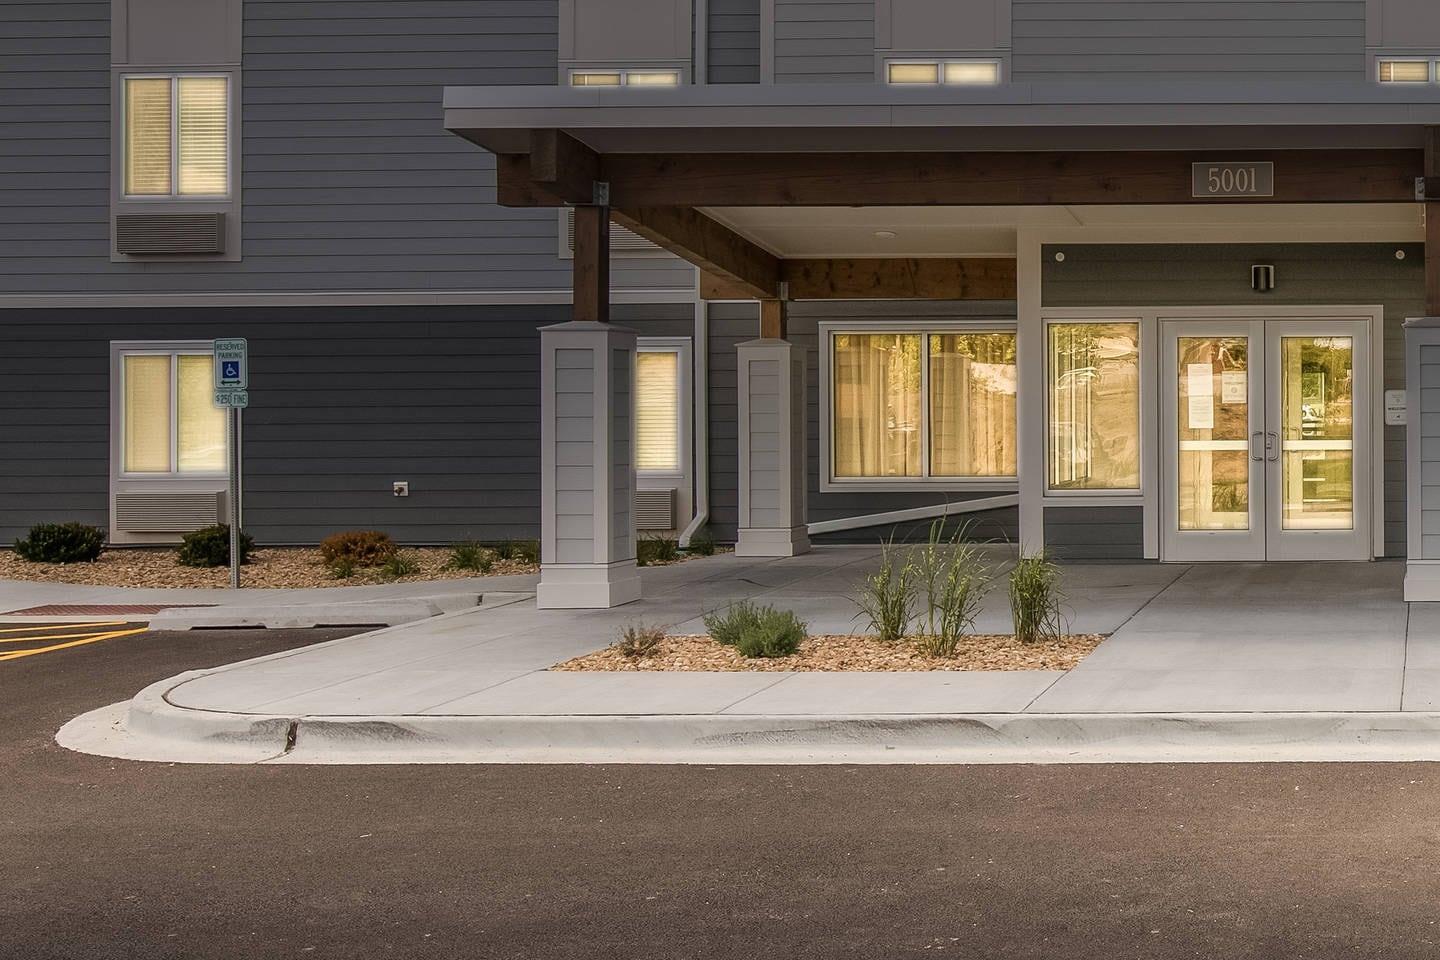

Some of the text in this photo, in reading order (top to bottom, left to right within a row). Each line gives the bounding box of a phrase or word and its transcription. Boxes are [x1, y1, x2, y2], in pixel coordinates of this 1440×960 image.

[1208, 167, 1257, 193] 5001
[216, 343, 245, 351] RESERVED
[218, 351, 243, 359] PARKING
[215, 393, 246, 404] $250 FINE
